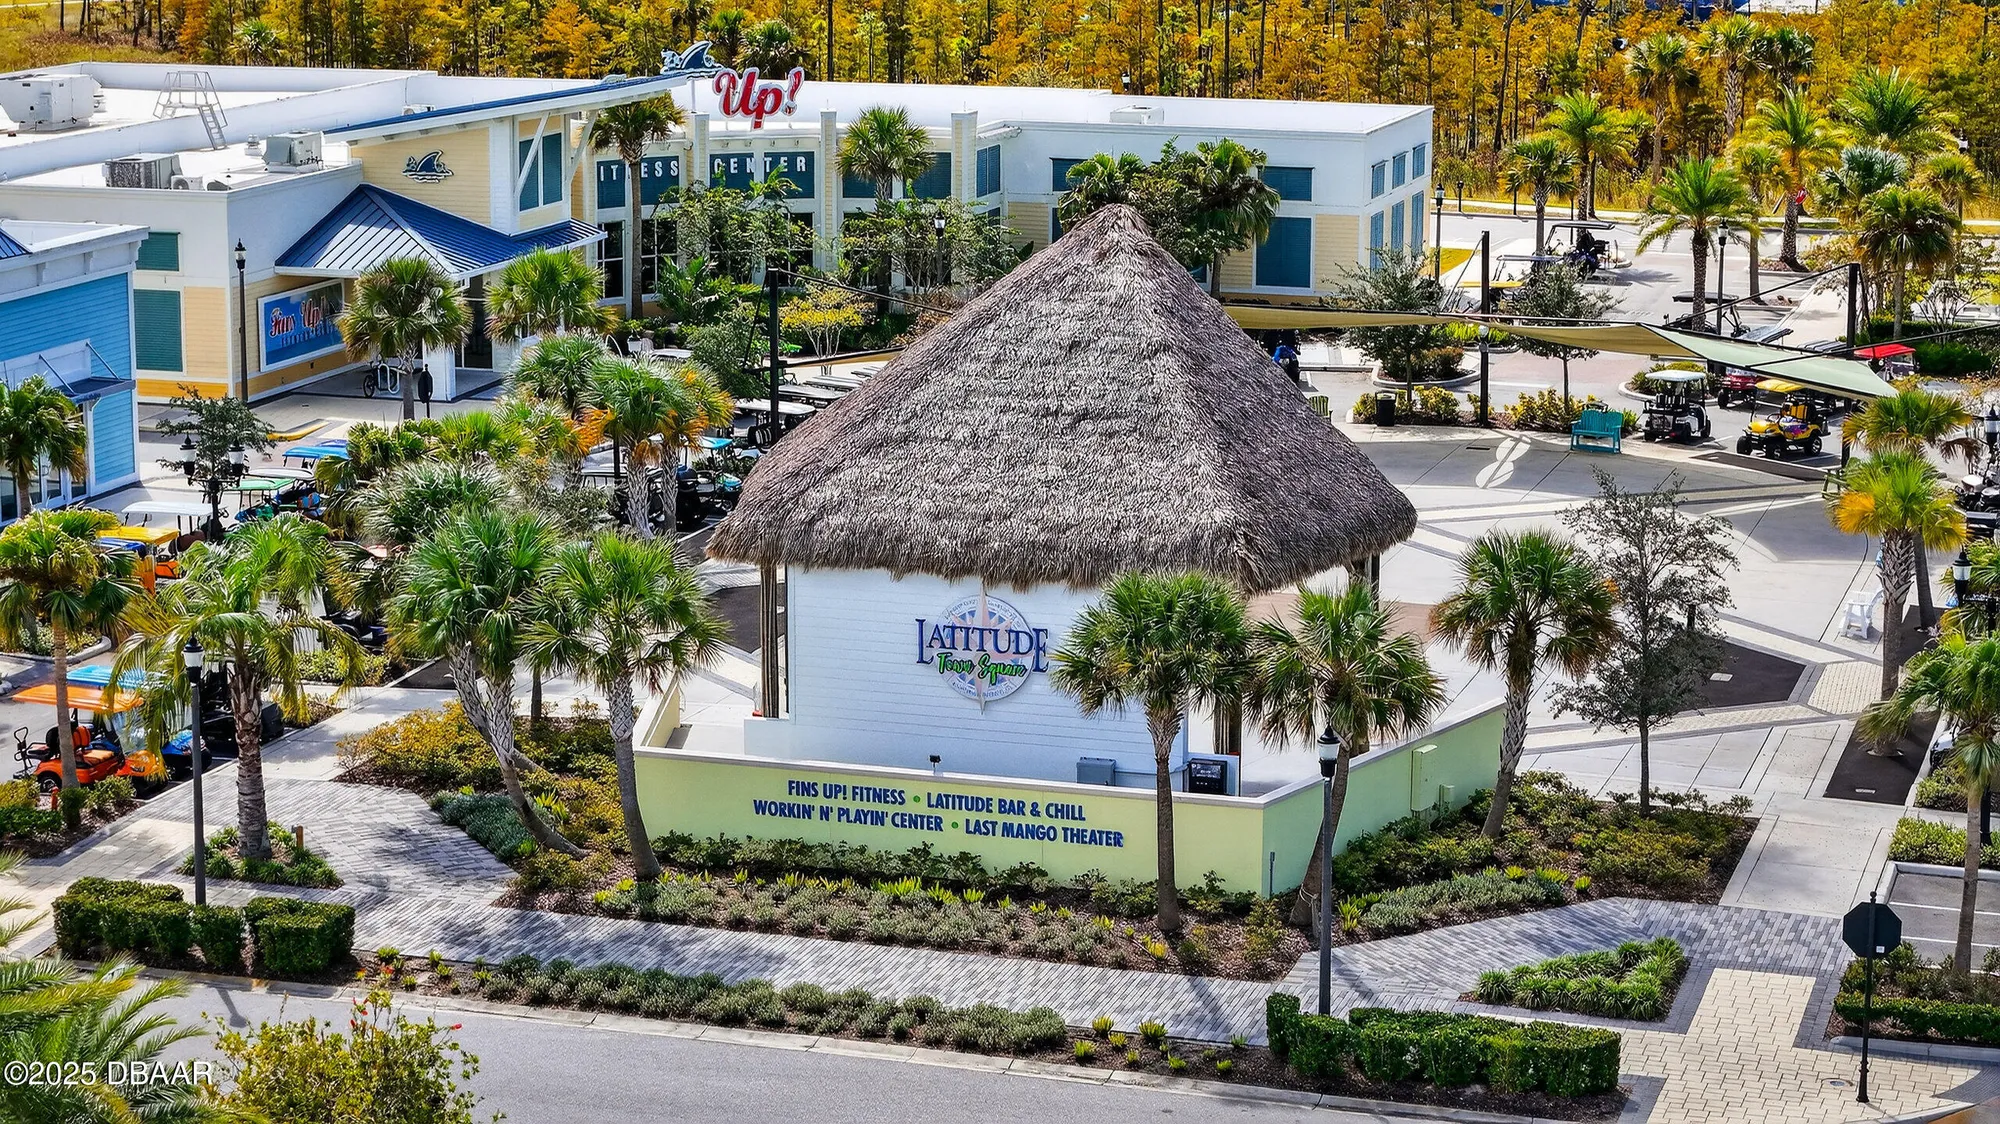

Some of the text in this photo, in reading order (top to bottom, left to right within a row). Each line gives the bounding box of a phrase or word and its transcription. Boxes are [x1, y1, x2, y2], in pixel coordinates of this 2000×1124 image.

[712, 66, 804, 130] Up!
[915, 618, 1050, 673] LATITUDE
[937, 652, 1028, 686] Town Square
[753, 799, 1124, 848] WORKIN' N' PLAYIN' CENTER LAST MANGO THEATER
[788, 780, 1086, 821] FINS UP! FITNESS LATITUDE BAR & CHILL
